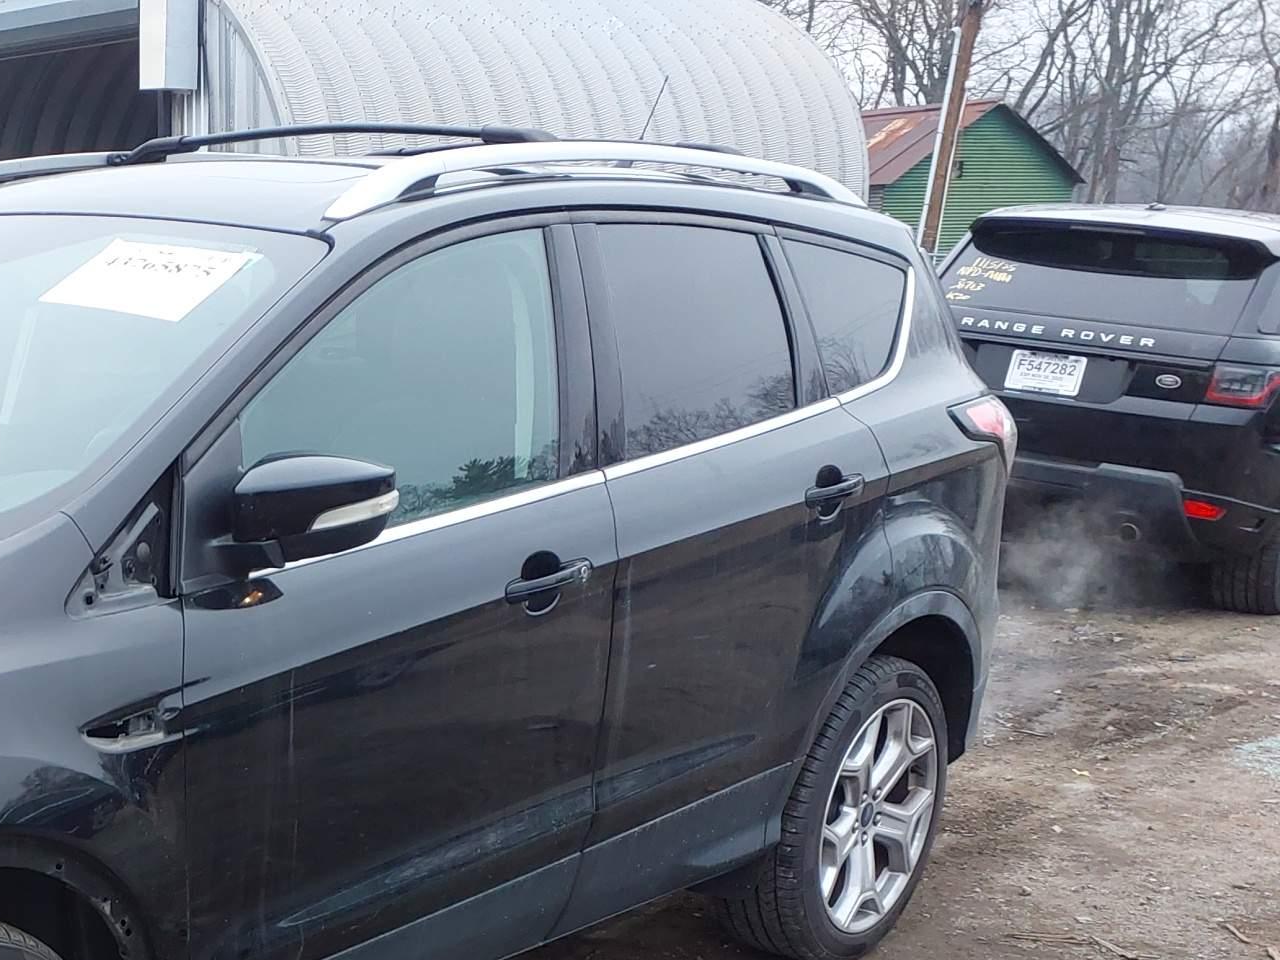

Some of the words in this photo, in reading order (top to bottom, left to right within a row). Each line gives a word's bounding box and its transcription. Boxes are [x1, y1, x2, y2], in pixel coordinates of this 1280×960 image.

[960, 316, 1046, 336] RANGE
[1060, 327, 1156, 348] ROVER
[1016, 358, 1077, 377] F547282
